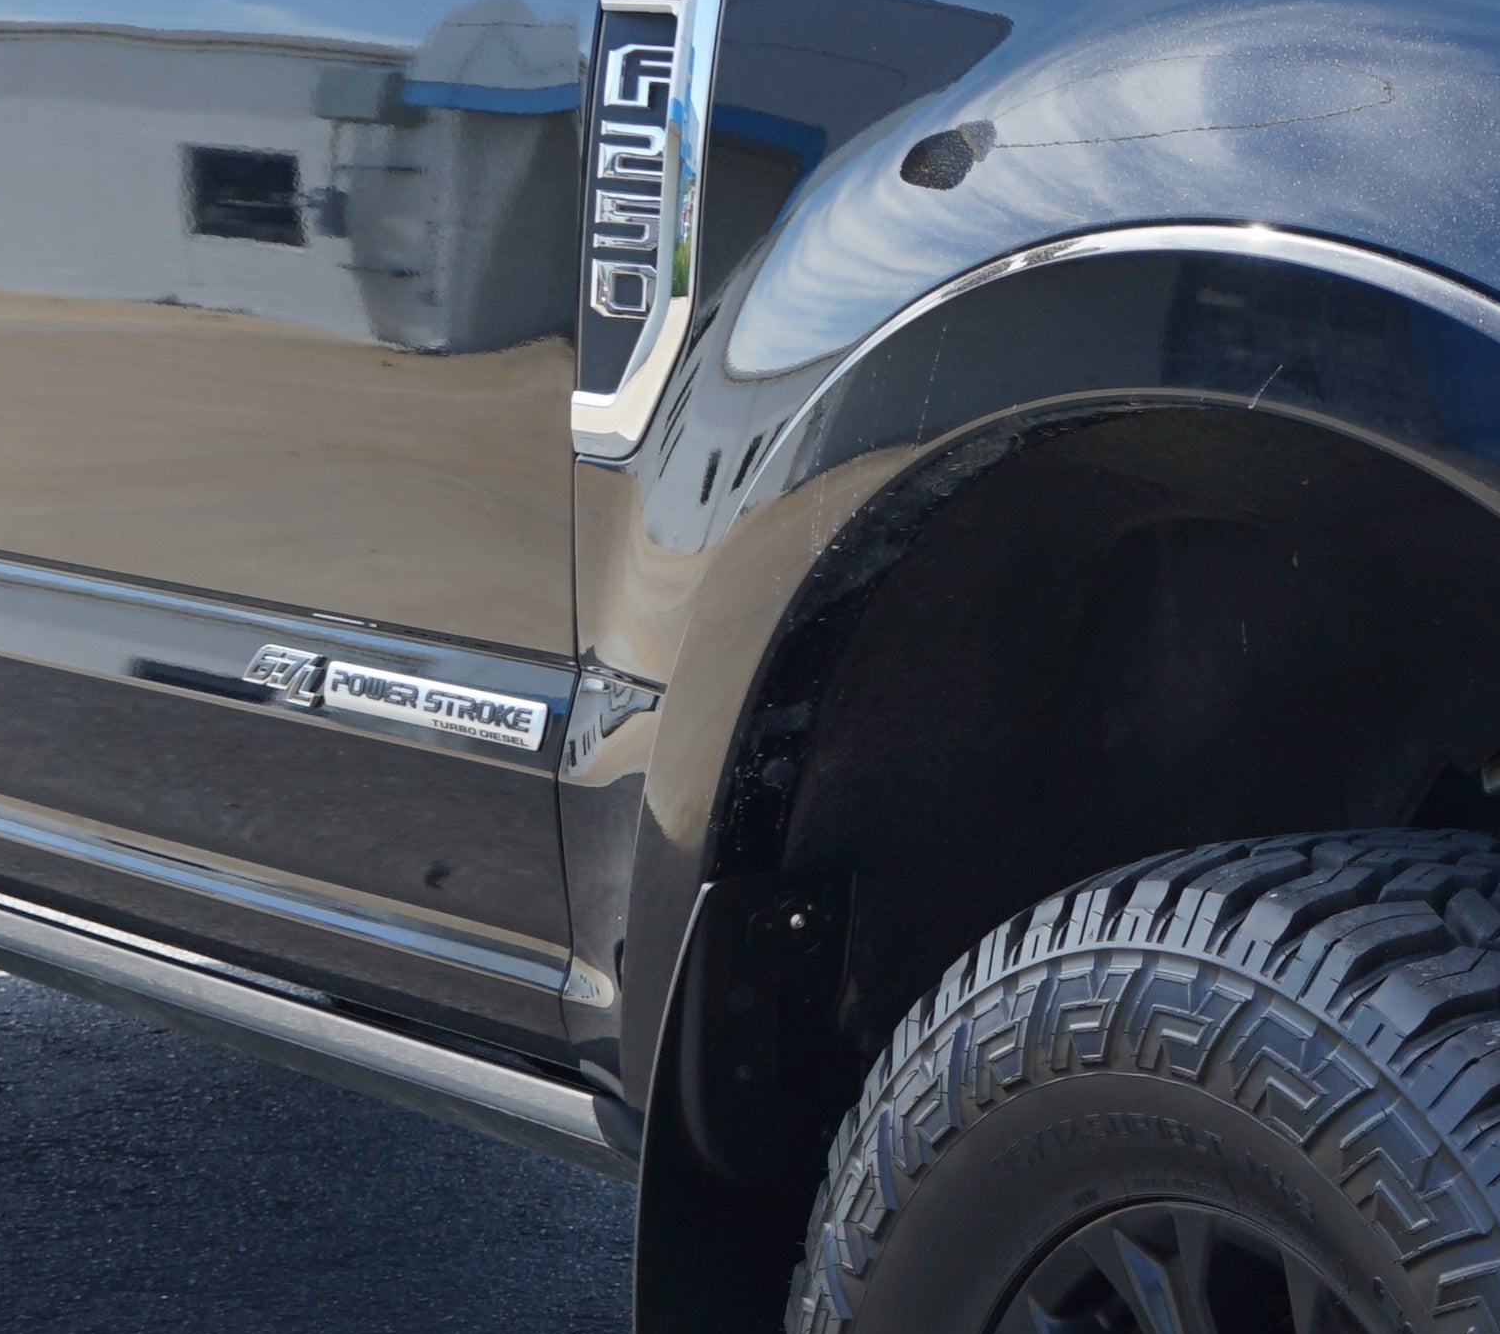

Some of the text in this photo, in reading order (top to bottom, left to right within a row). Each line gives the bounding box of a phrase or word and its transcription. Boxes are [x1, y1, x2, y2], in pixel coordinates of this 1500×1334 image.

[245, 644, 531, 733] 6.7L POWER STROKE
[433, 719, 529, 747] TURBO DIESEL
